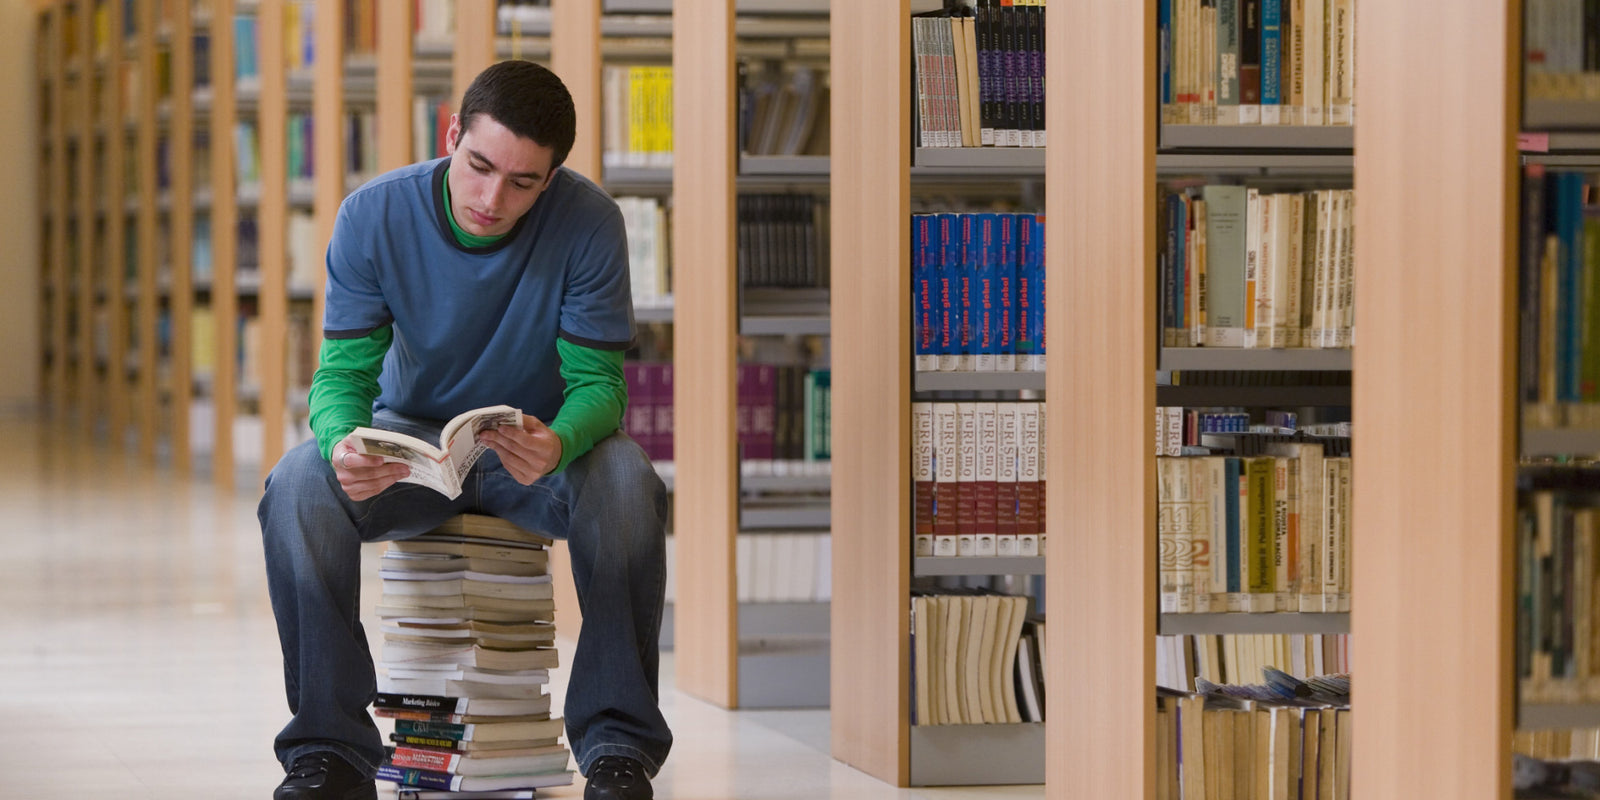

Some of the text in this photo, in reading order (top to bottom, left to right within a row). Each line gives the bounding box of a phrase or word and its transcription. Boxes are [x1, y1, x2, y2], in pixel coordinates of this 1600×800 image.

[1248, 250, 1256, 279] MALTHUS
[921, 280, 930, 309] global
[982, 279, 991, 309] global
[1020, 278, 1029, 308] global
[941, 278, 950, 347] Turismo global
[961, 277, 970, 346] Turismo global
[1001, 277, 1010, 346] Turismo global
[402, 697, 426, 708] Marketing
